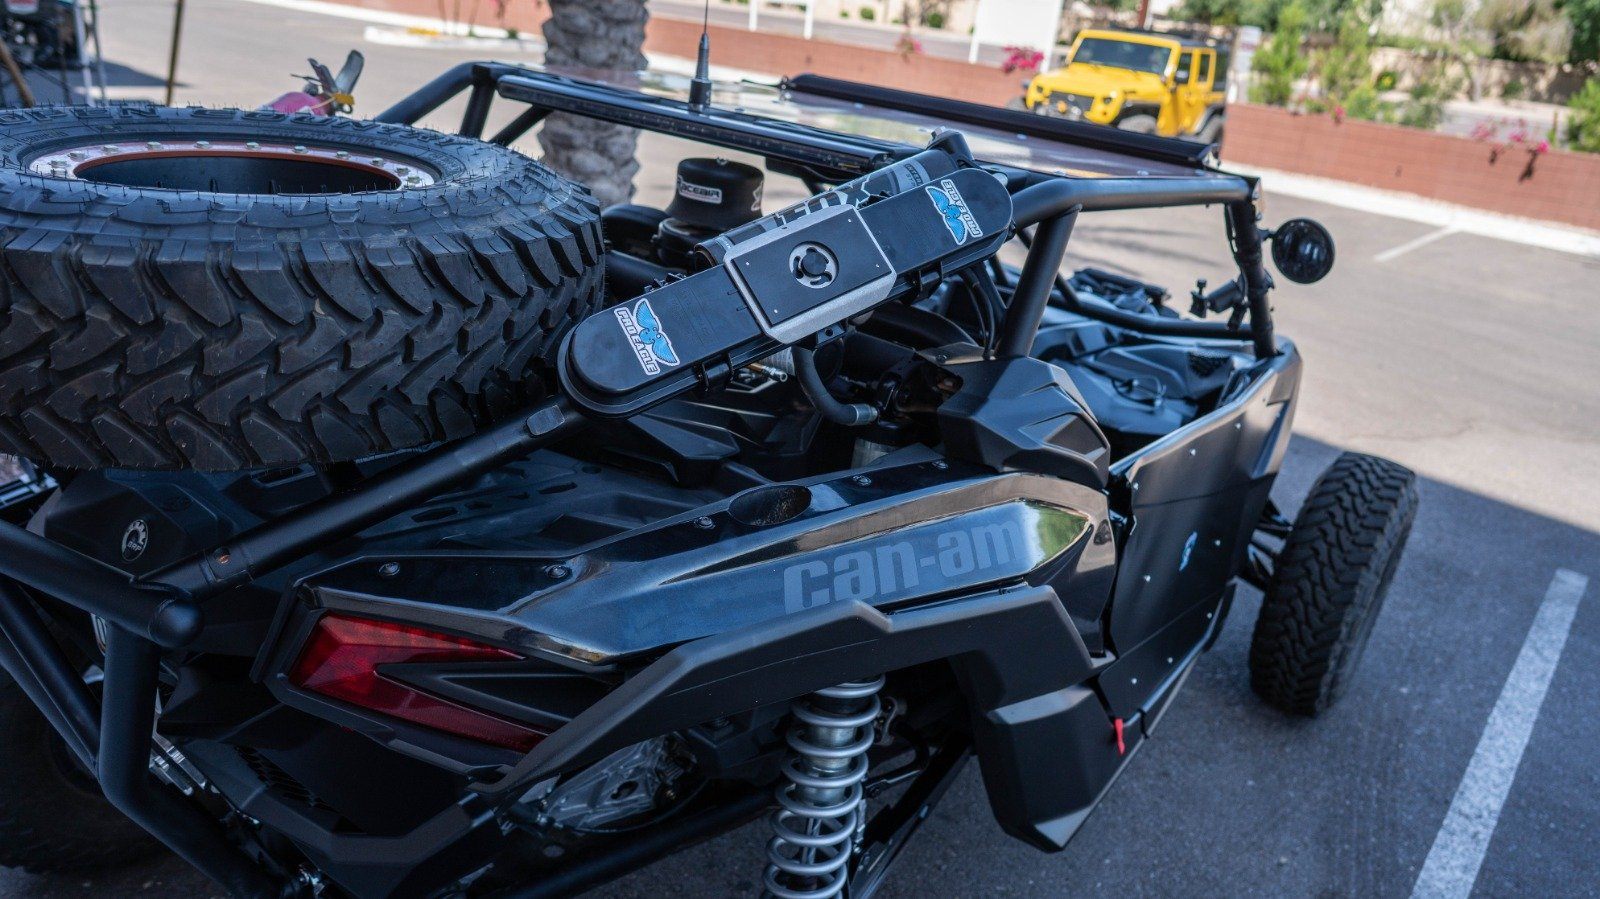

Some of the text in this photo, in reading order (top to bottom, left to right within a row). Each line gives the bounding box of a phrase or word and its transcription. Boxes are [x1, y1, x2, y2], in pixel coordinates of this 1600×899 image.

[943, 180, 981, 235] PRO EAGLE
[616, 309, 658, 373] PRO EAGLE
[127, 541, 142, 551] BRP
[784, 521, 1023, 614] can-am
